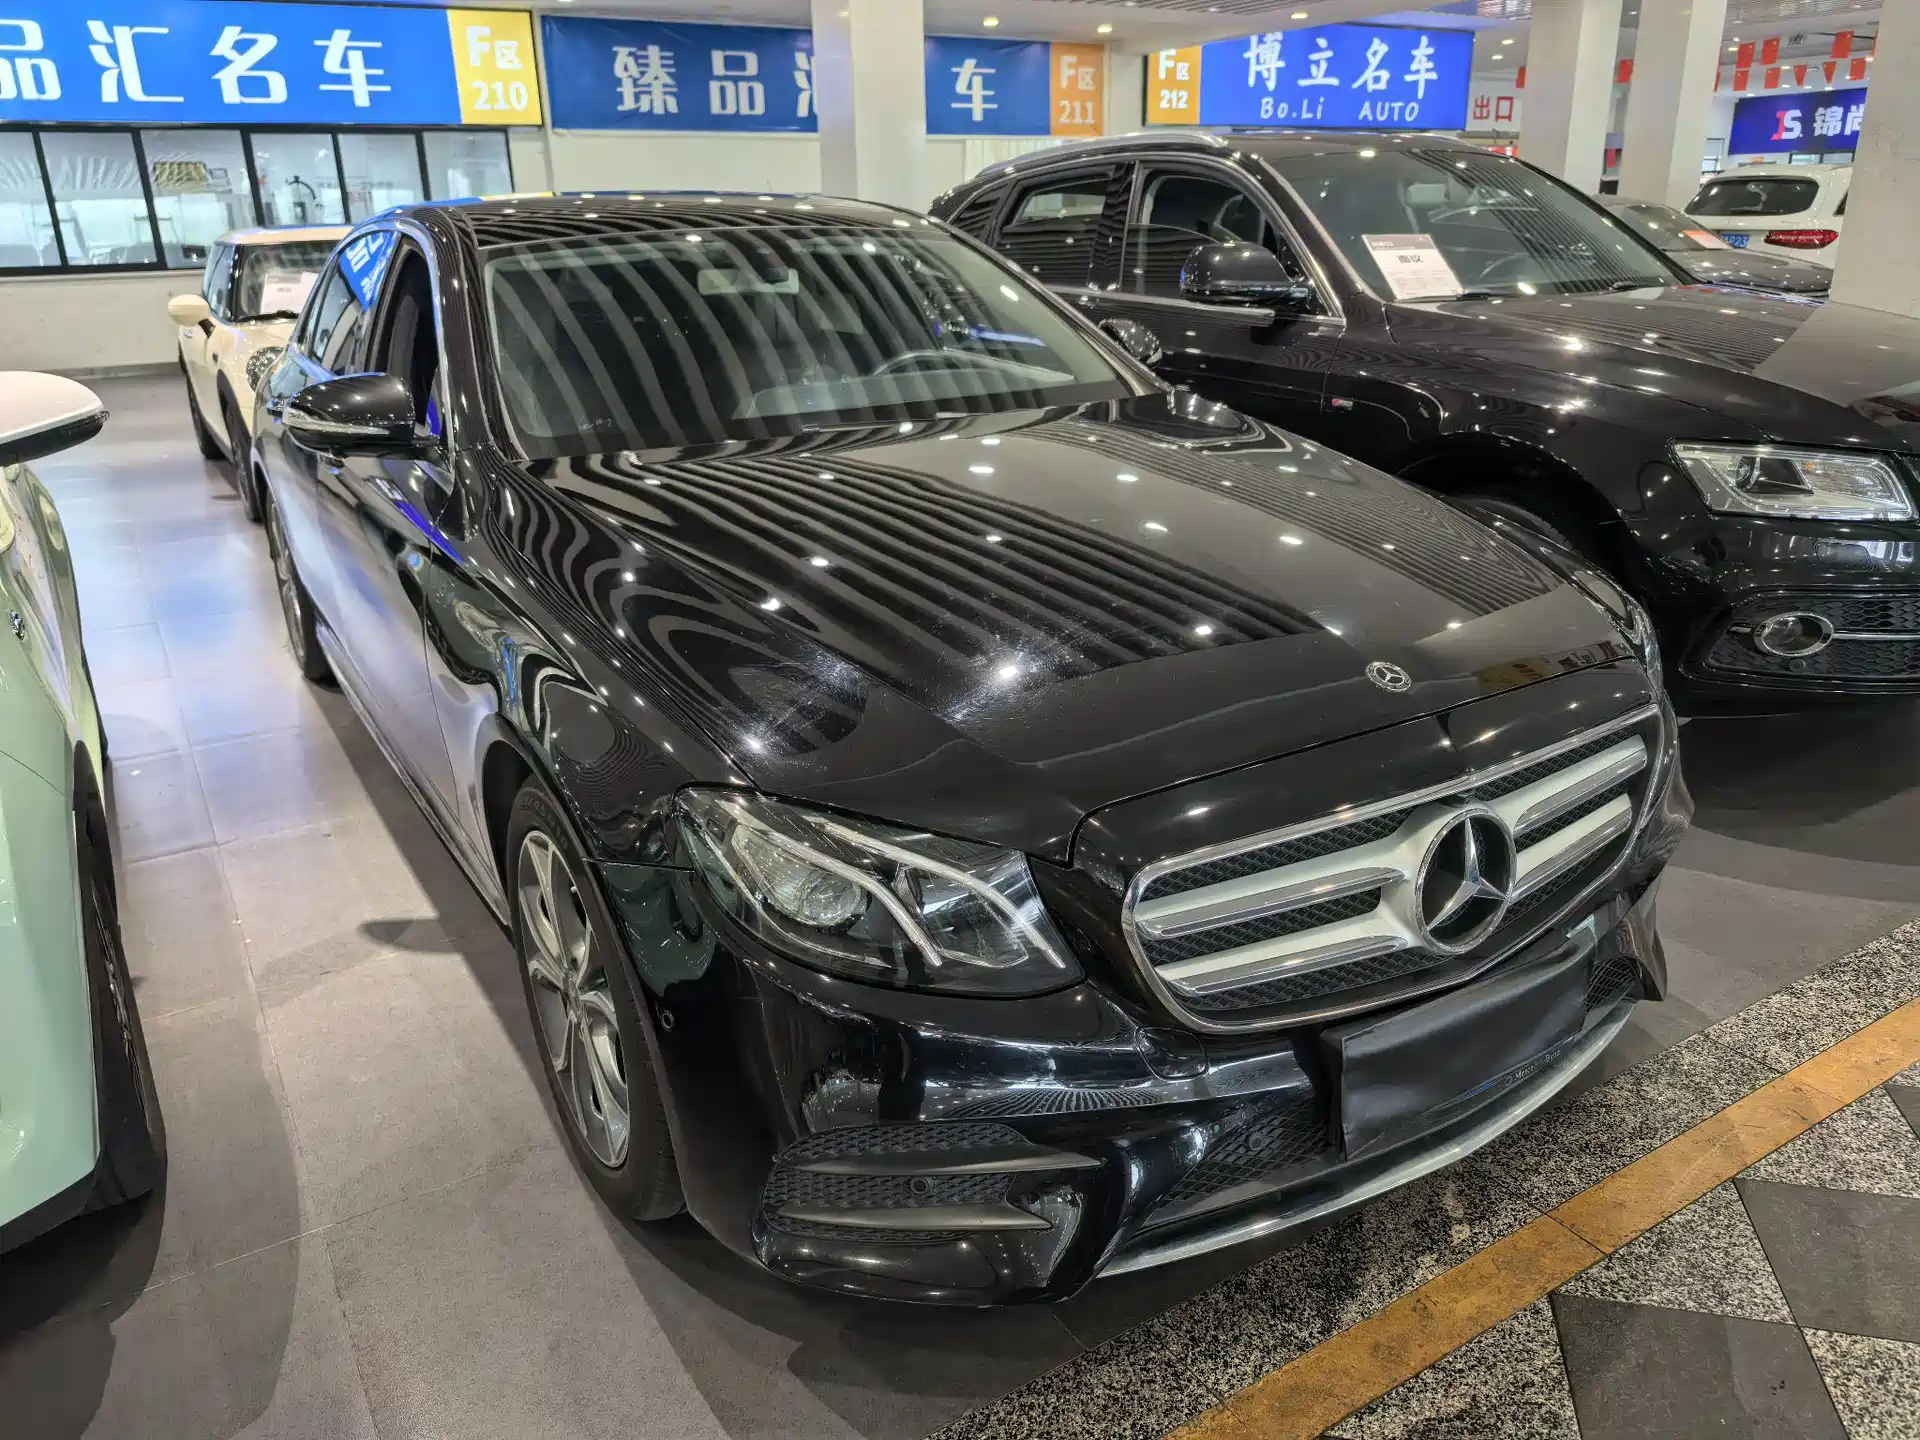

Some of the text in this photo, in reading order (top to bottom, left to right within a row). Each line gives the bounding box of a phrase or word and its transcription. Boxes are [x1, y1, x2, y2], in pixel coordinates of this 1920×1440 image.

[0, 19, 392, 108] 品汇名车
[465, 26, 524, 70] F区
[1060, 55, 1096, 91] F区
[1159, 49, 1190, 81] F区
[1243, 31, 1439, 99] 博立名车
[471, 80, 529, 112] 210
[1160, 88, 1189, 110] 212
[1358, 100, 1419, 122] AUTO
[1473, 94, 1514, 122] 出口
[1059, 100, 1096, 125] 211
